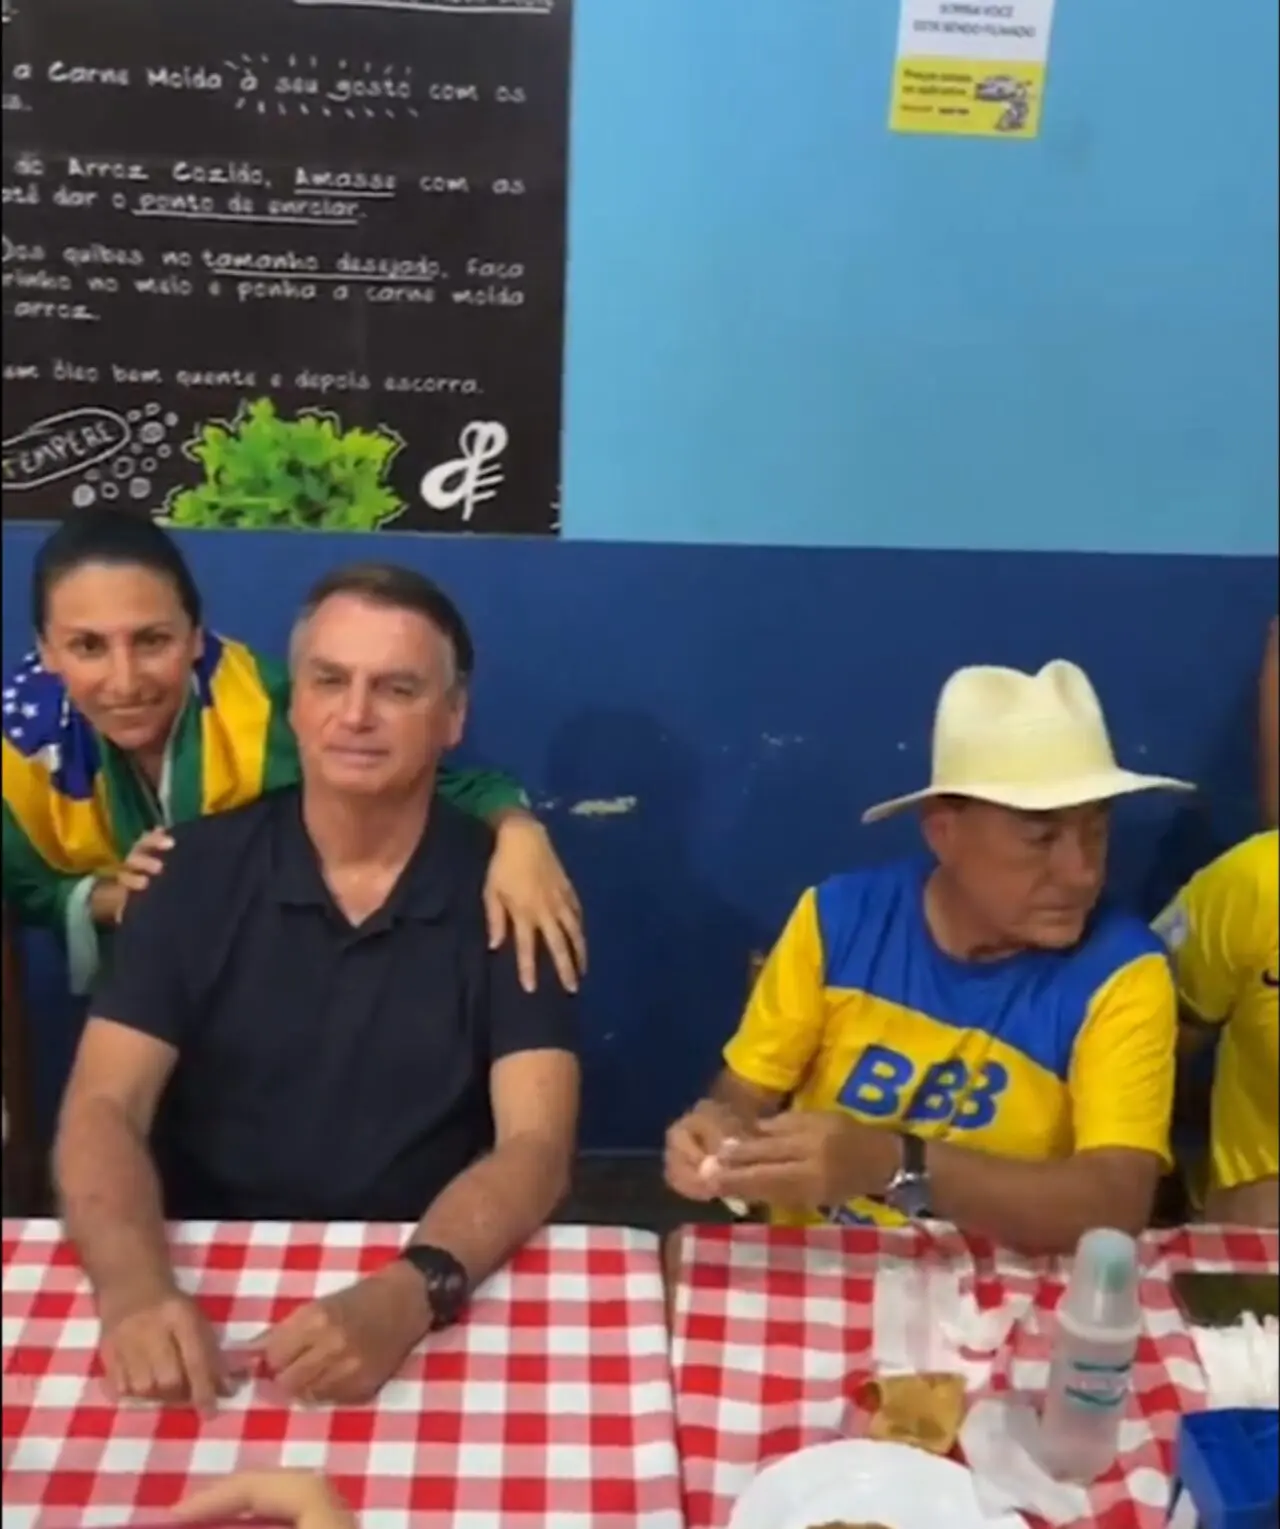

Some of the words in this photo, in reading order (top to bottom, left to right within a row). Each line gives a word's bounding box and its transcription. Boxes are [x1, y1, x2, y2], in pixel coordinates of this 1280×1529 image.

[48, 60, 130, 86] Carne
[275, 76, 319, 95] seu
[326, 79, 411, 101] gosto
[429, 82, 478, 101] com
[496, 85, 527, 102] os
[69, 156, 149, 180] Arroz
[295, 166, 396, 190] Amasse
[419, 176, 469, 192] com
[53, 184, 98, 206] dar
[112, 192, 126, 209] o
[139, 192, 214, 213] ponto
[162, 251, 192, 267] no
[201, 249, 319, 270] tamanho
[87, 276, 119, 293] no
[236, 279, 316, 302] ponha
[333, 284, 349, 301] a
[366, 285, 435, 304] carne
[112, 364, 163, 385] bem
[176, 368, 256, 388] quente
[270, 372, 283, 389] e
[295, 369, 371, 394] depois
